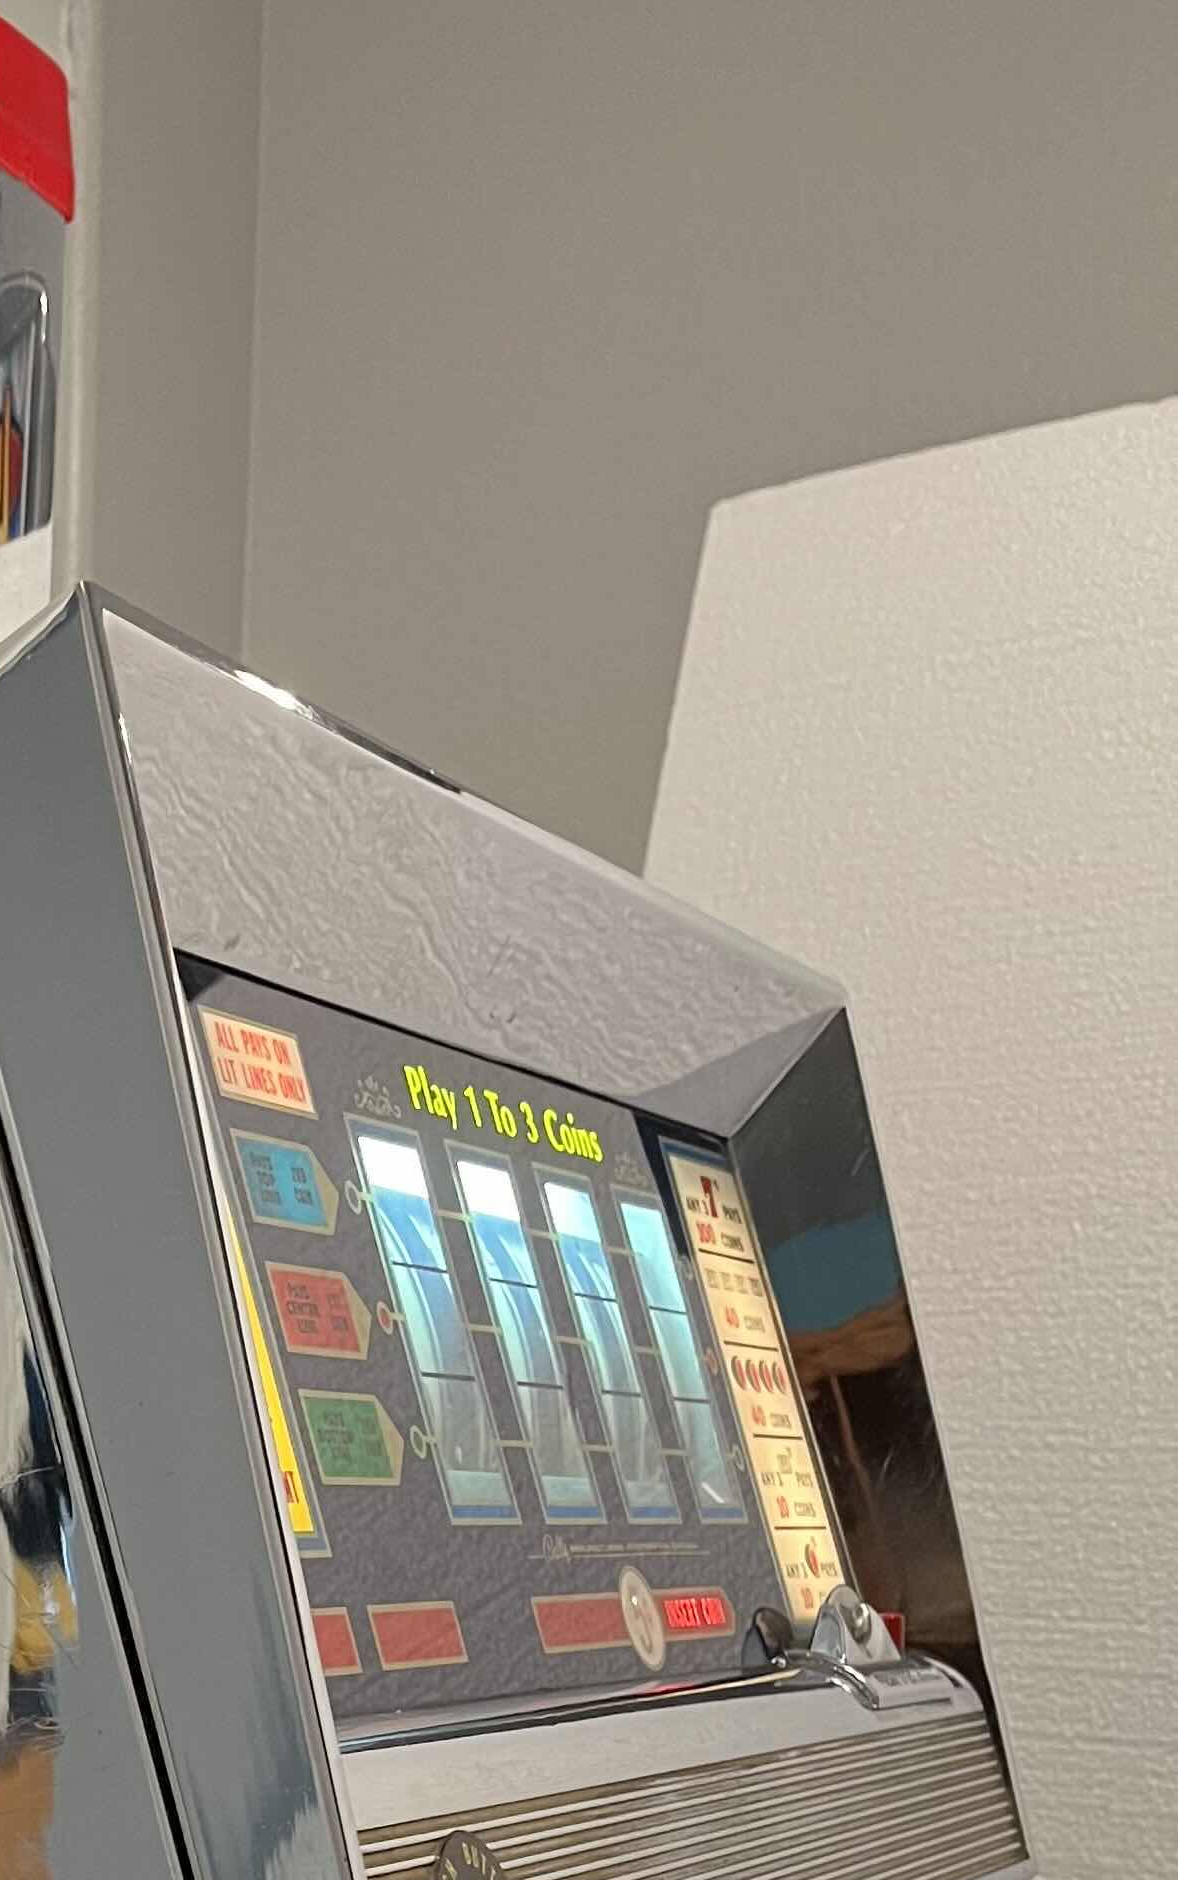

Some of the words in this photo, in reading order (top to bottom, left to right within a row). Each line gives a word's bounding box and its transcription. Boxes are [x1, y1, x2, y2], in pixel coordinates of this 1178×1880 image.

[213, 1020, 239, 1053] ALL
[240, 1028, 272, 1061] PAYS
[216, 1056, 238, 1086] LIT
[241, 1063, 277, 1096] LINES
[277, 1071, 308, 1104] ONLY
[403, 1065, 458, 1130] Play
[463, 1085, 482, 1128] 1
[483, 1089, 518, 1138] To
[519, 1101, 540, 1144] 3
[543, 1108, 604, 1162] Coins
